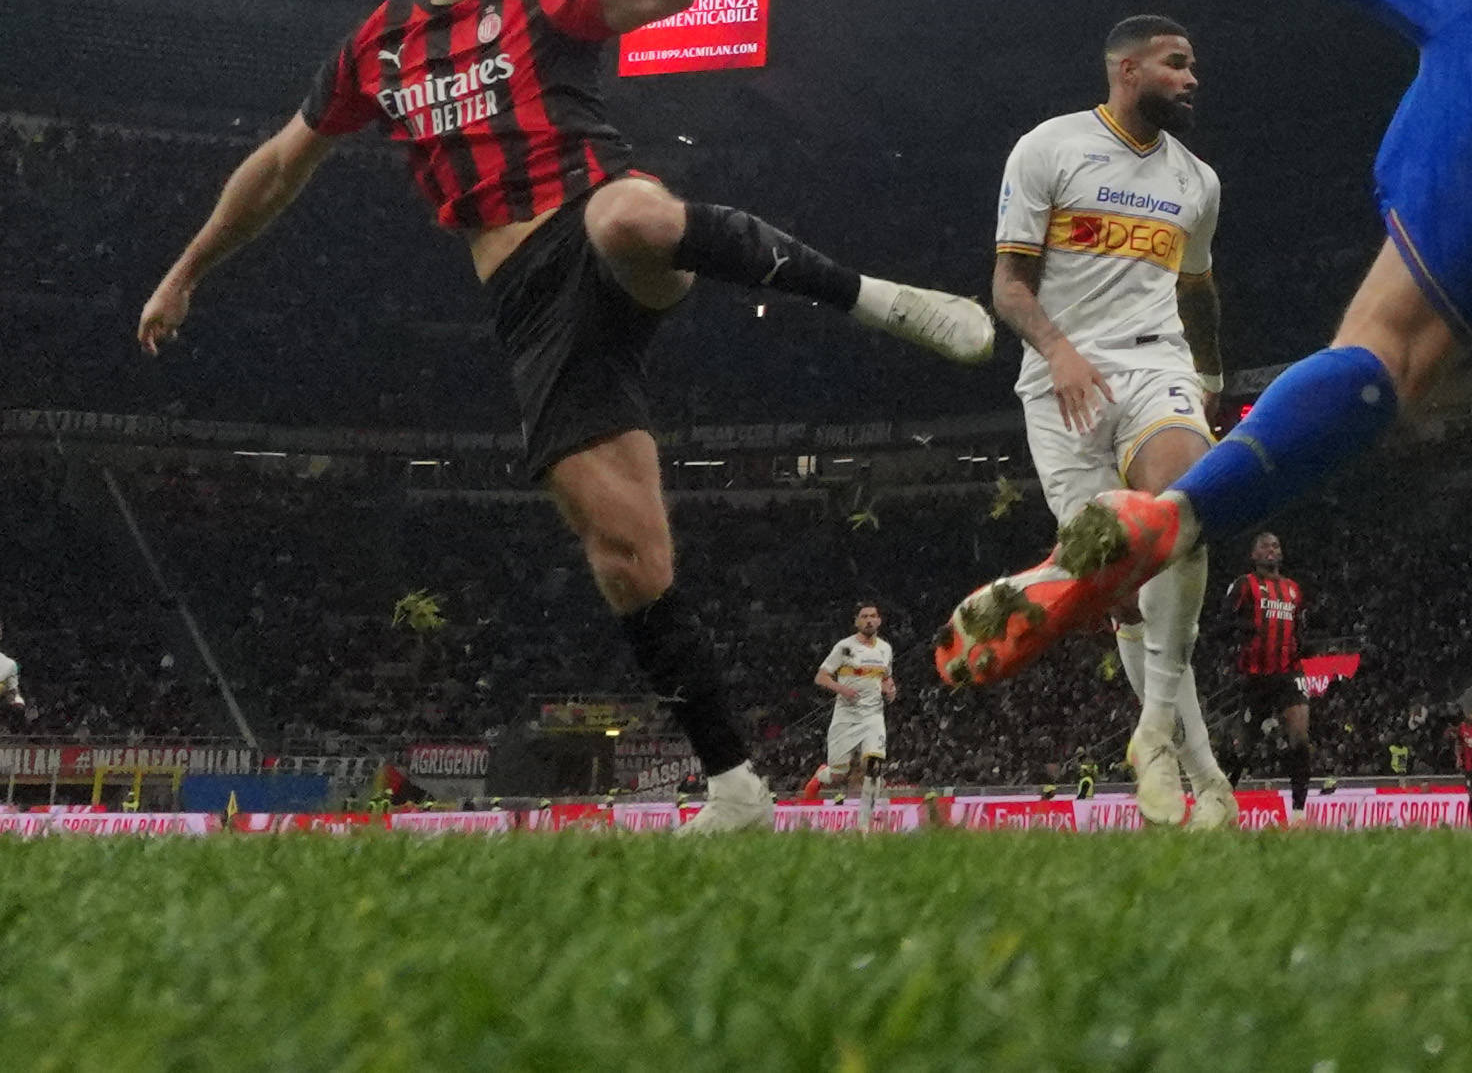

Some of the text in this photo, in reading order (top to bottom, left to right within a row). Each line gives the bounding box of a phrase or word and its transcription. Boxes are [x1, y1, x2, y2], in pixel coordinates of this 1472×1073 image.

[641, 7, 758, 29] IMENTICABILE
[628, 43, 758, 62] CLUB1899.ACMILAN.COM
[376, 53, 515, 120] Emirates
[431, 90, 499, 135] BETTER
[1097, 186, 1160, 213] Betitaly
[1169, 386, 1194, 415] 5
[409, 748, 489, 776] AGRIGENTO
[994, 806, 1072, 832] Emirates
[1400, 801, 1449, 828] SPORT
